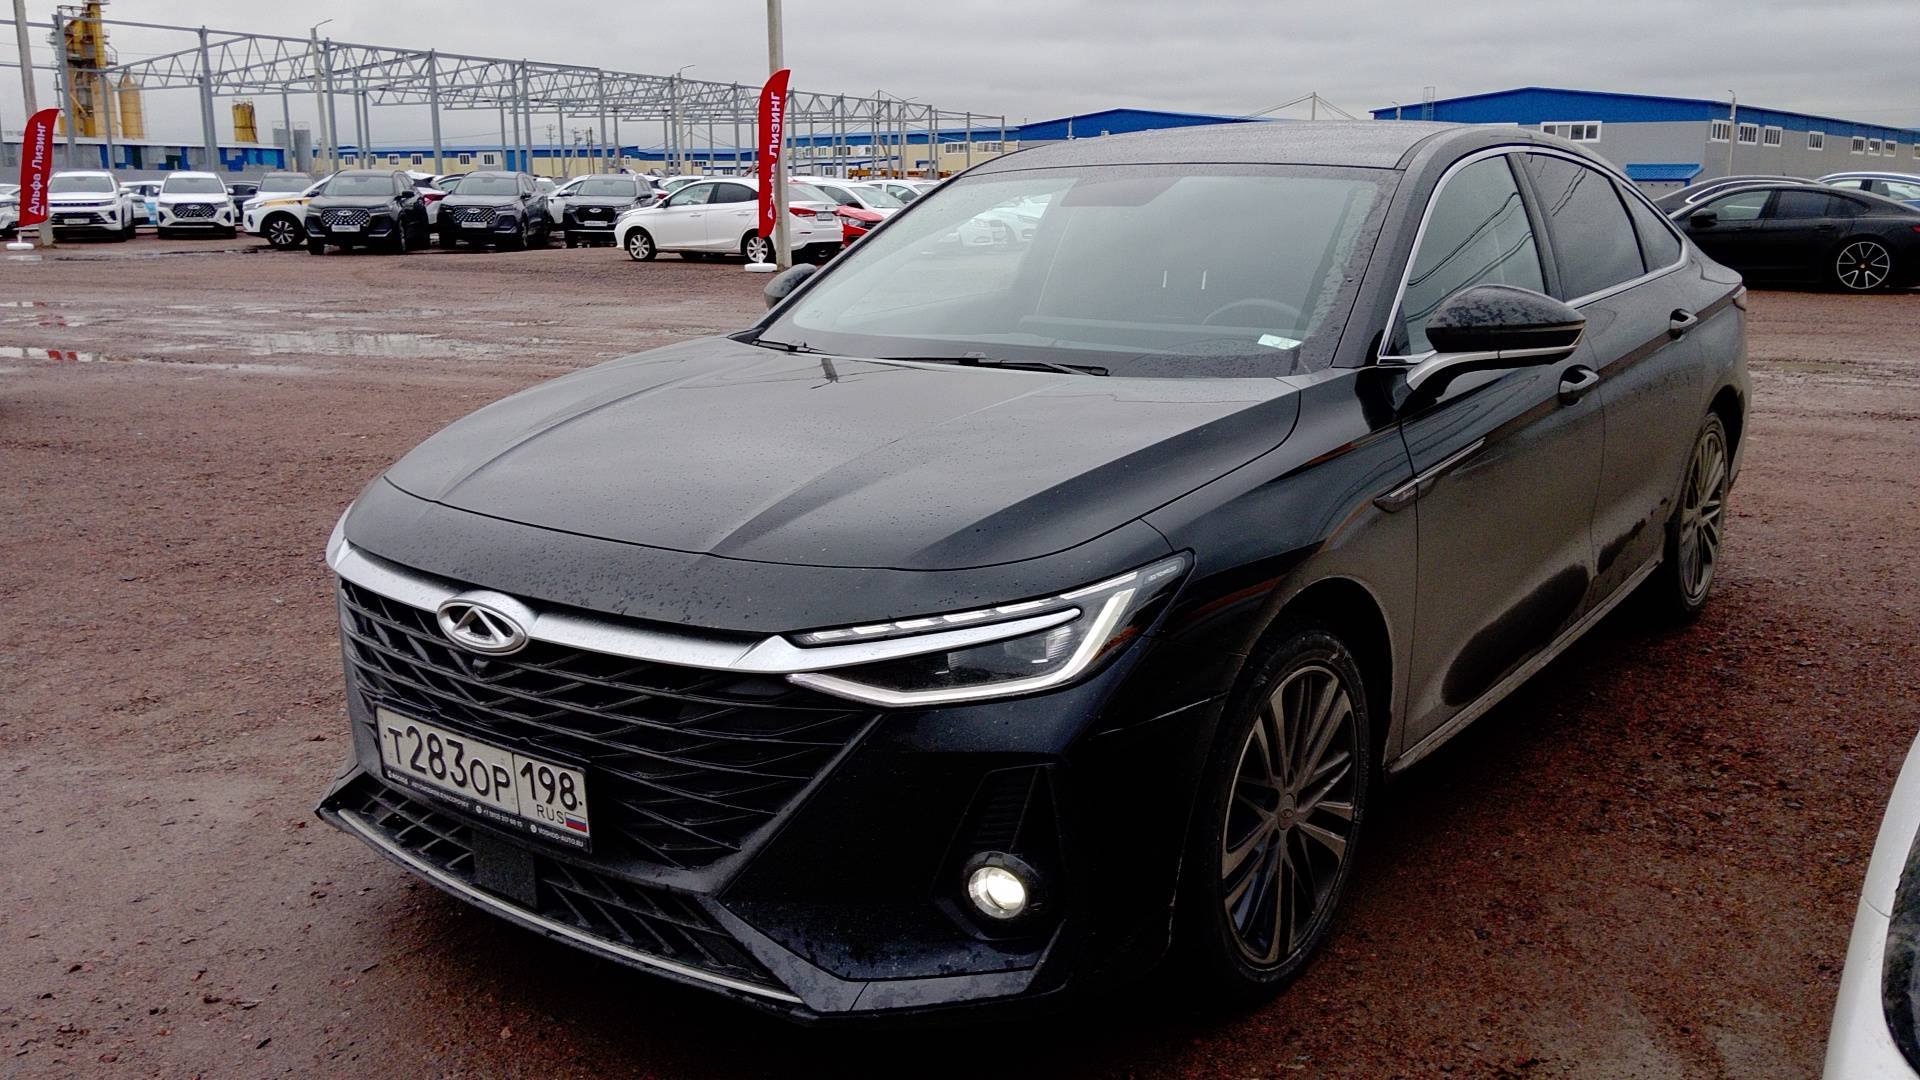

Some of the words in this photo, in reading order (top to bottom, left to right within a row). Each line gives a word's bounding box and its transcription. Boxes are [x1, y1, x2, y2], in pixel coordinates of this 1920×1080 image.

[31, 122, 46, 170] Лизинг
[769, 91, 781, 159] Лизинг
[28, 174, 43, 215] Альфа
[387, 725, 511, 802] Т283ОР
[520, 761, 578, 811] 198
[536, 803, 565, 825] RUS
